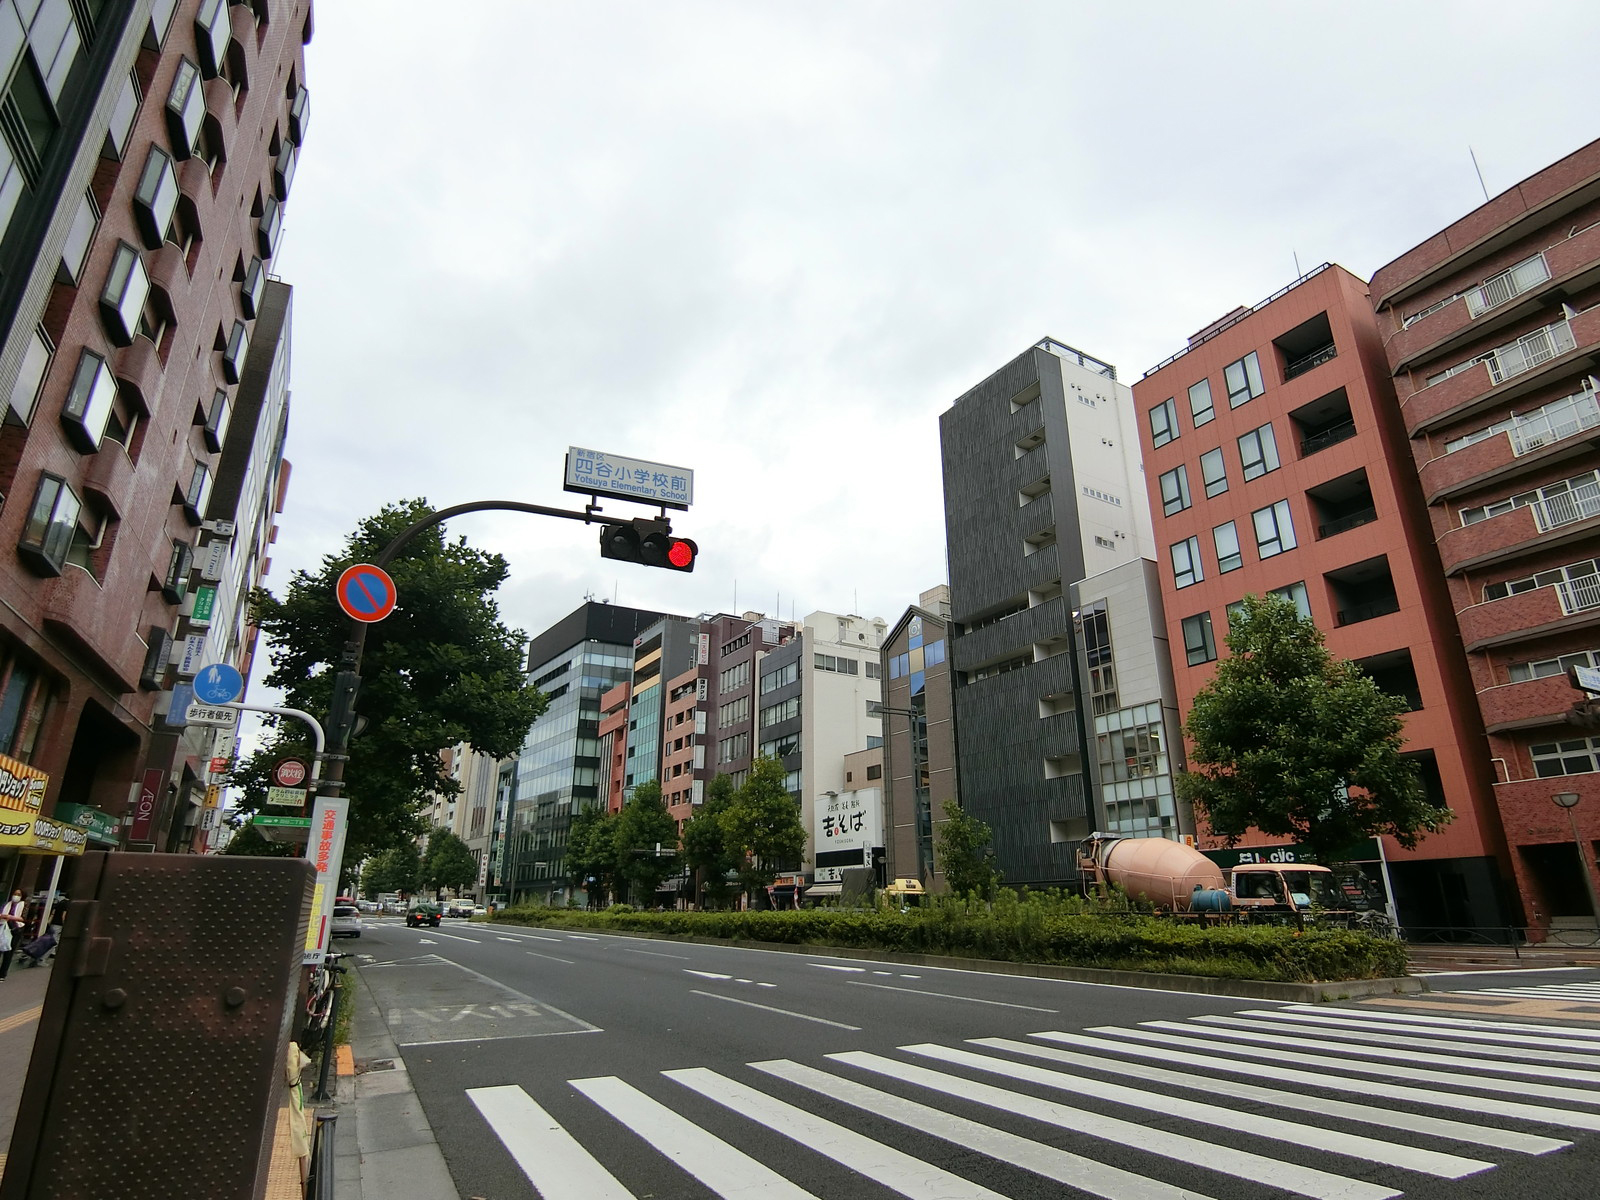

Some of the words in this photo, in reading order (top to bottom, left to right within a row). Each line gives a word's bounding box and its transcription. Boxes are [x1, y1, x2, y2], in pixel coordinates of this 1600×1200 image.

[576, 449, 605, 462] 新宿区
[574, 473, 608, 488] Yotsuya
[611, 480, 657, 498] Elementary
[660, 488, 688, 501] School
[575, 458, 688, 492] 四谷小学校前
[189, 708, 233, 721] 歩行者優先
[0, 767, 29, 799] 円ショップ
[280, 768, 303, 779] 消火栓
[34, 819, 62, 840] 100円ショップ
[822, 810, 866, 838] 吉そば
[315, 809, 337, 873] 交通事故多発
